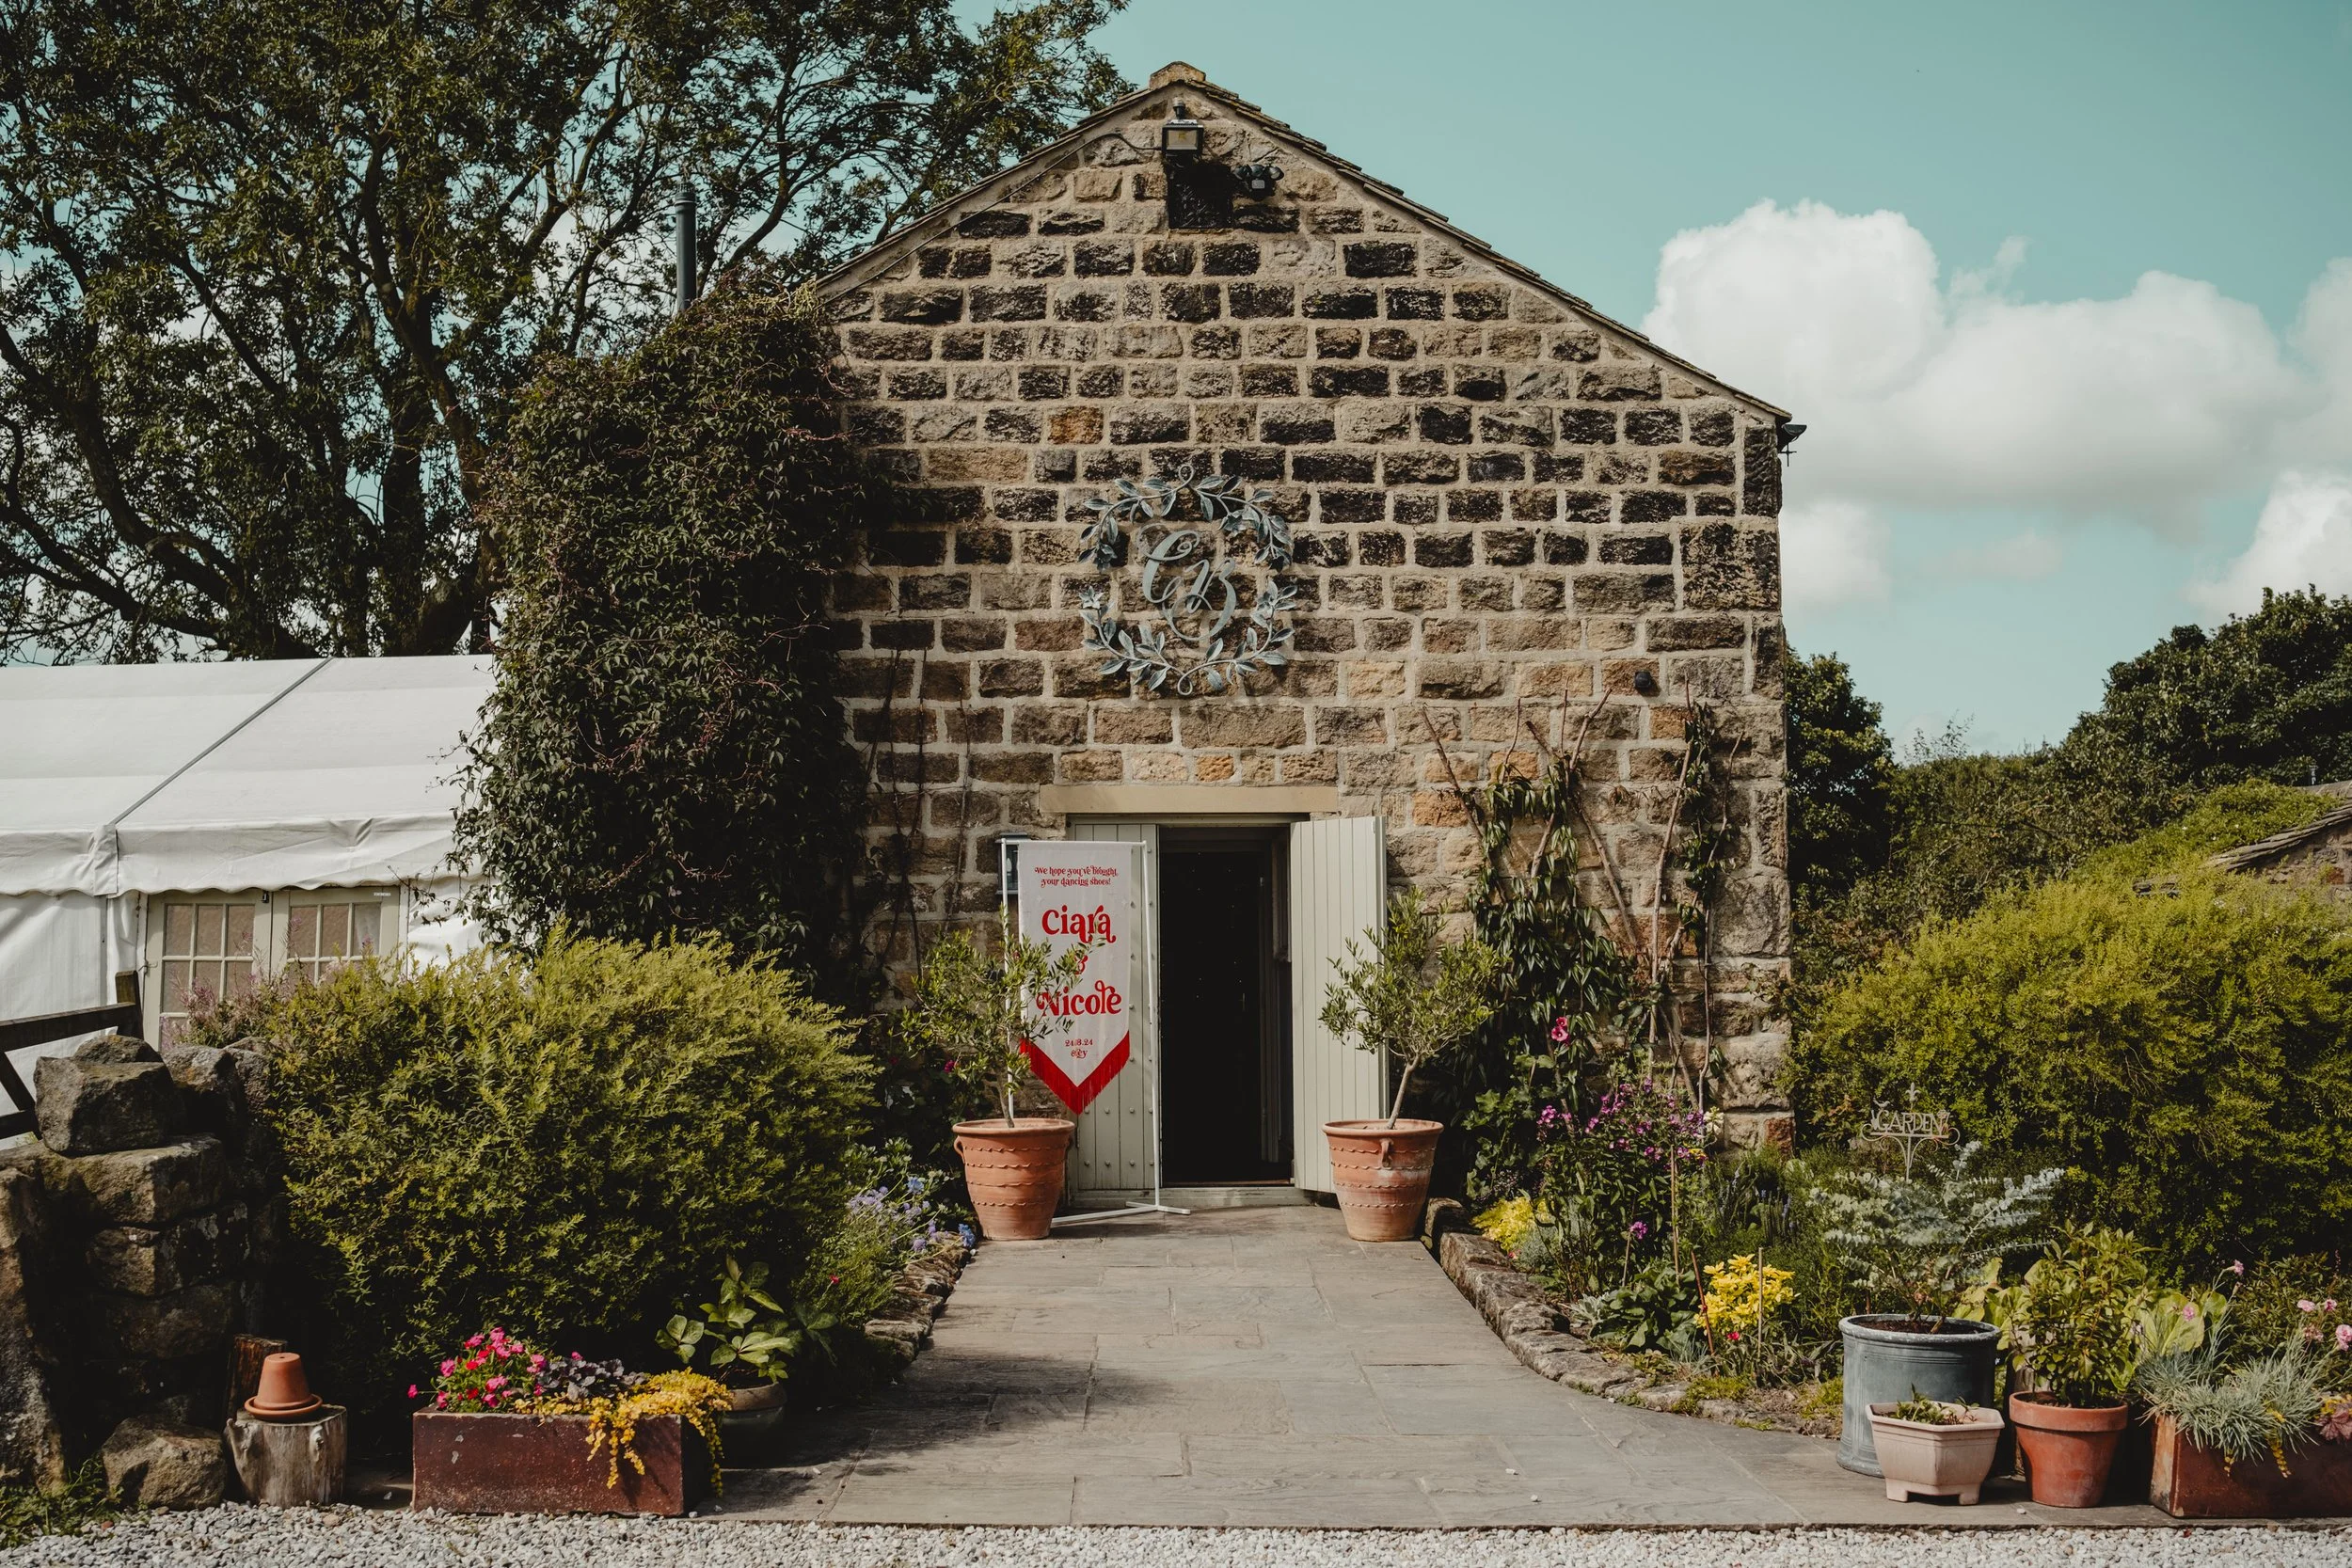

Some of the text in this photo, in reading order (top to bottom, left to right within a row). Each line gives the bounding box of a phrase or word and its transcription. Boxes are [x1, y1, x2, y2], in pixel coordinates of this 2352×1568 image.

[1034, 866, 1048, 875] We
[1049, 866, 1067, 877] hope
[1067, 866, 1091, 878] you've
[1041, 877, 1111, 888] your dancing shoes!
[1041, 905, 1117, 943] Ciara
[1036, 979, 1122, 1017] Nicole
[1876, 1110, 1944, 1136] GARDEN
